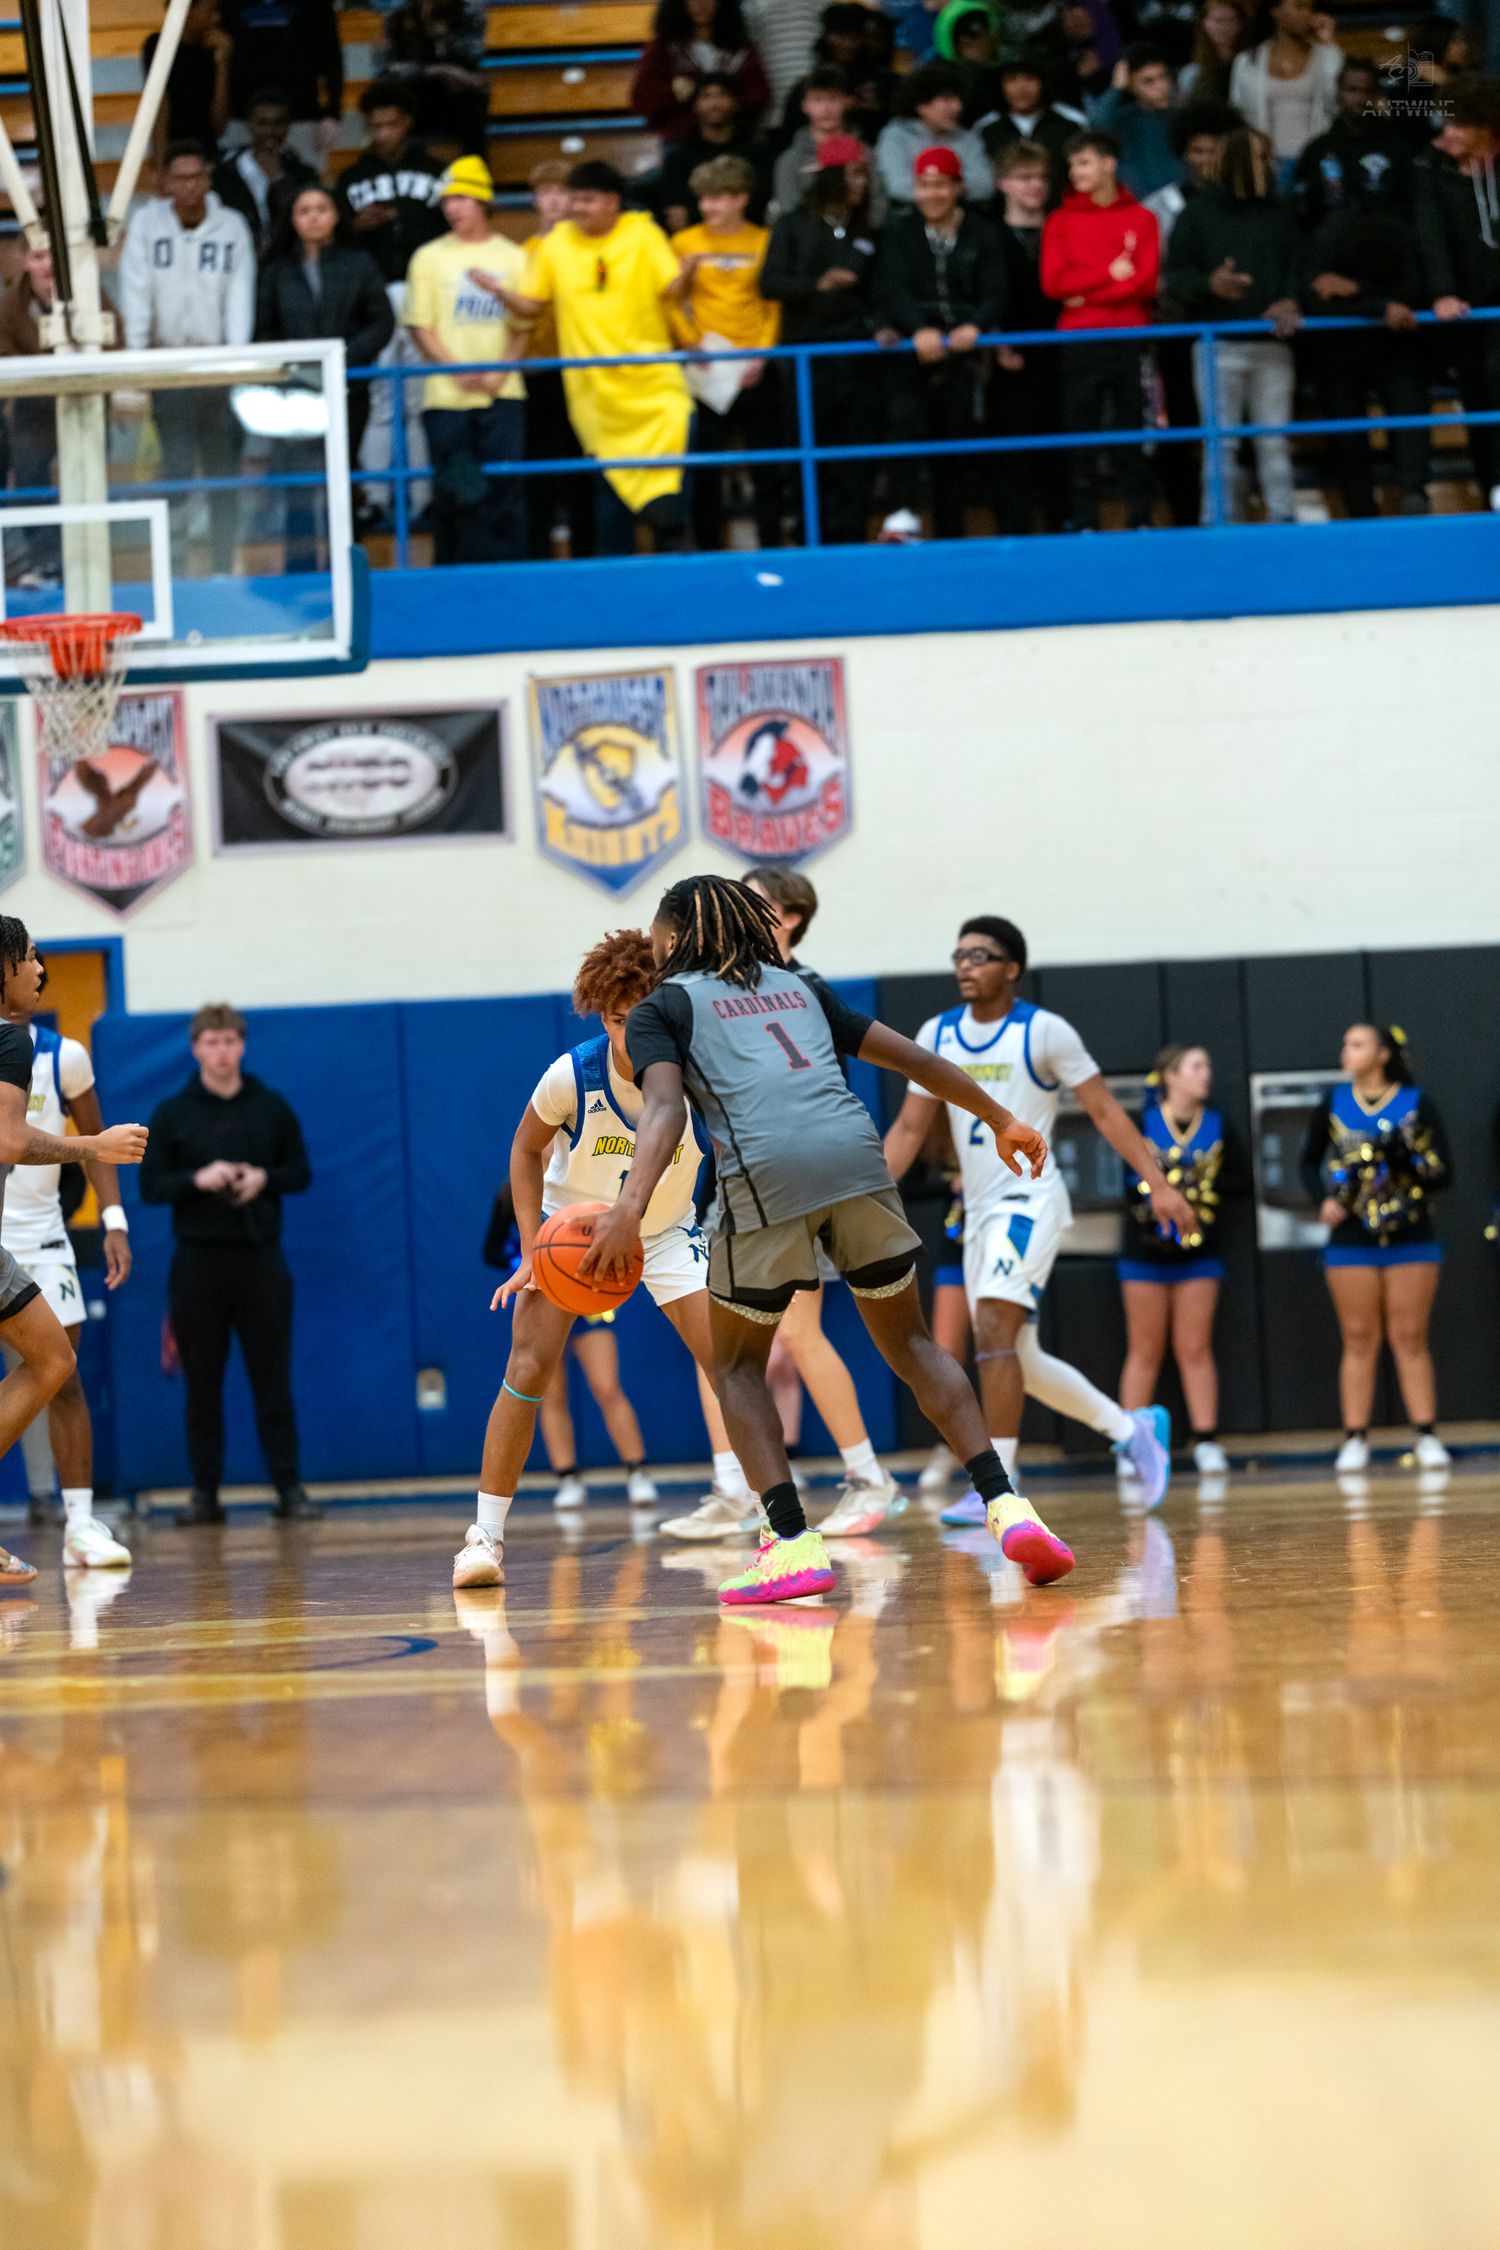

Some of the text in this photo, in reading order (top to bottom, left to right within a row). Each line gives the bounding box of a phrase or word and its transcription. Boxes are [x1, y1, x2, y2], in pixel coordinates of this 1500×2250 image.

[708, 775, 845, 854] BRAVES
[712, 991, 808, 1019] CARDINALS
[765, 1022, 812, 1070] 1
